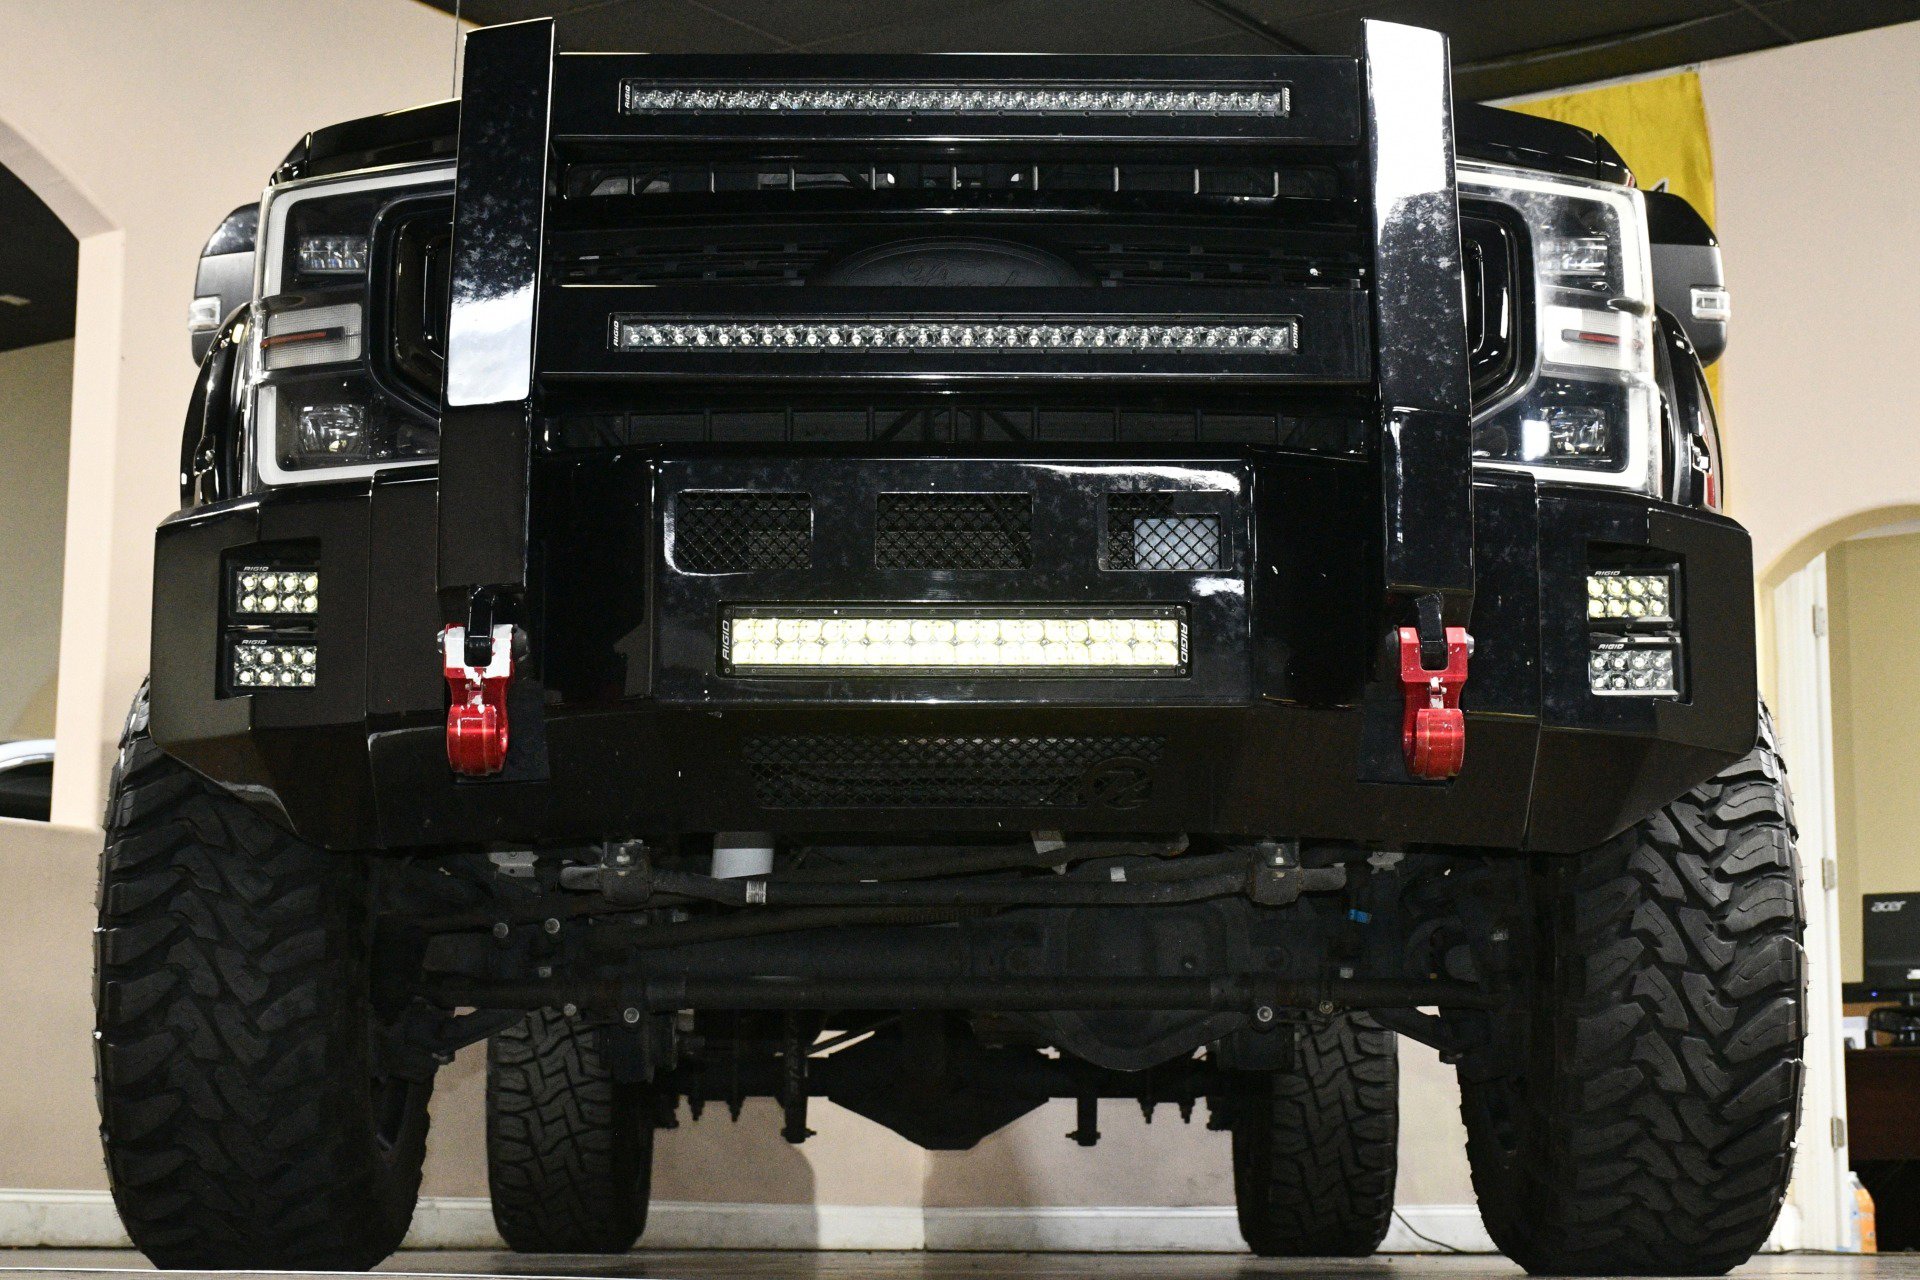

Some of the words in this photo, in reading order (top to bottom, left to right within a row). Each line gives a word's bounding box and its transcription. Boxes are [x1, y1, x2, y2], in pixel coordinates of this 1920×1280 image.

[722, 619, 730, 661] RIGID
[1180, 622, 1189, 664] RIGID
[1871, 900, 1907, 913] acer
